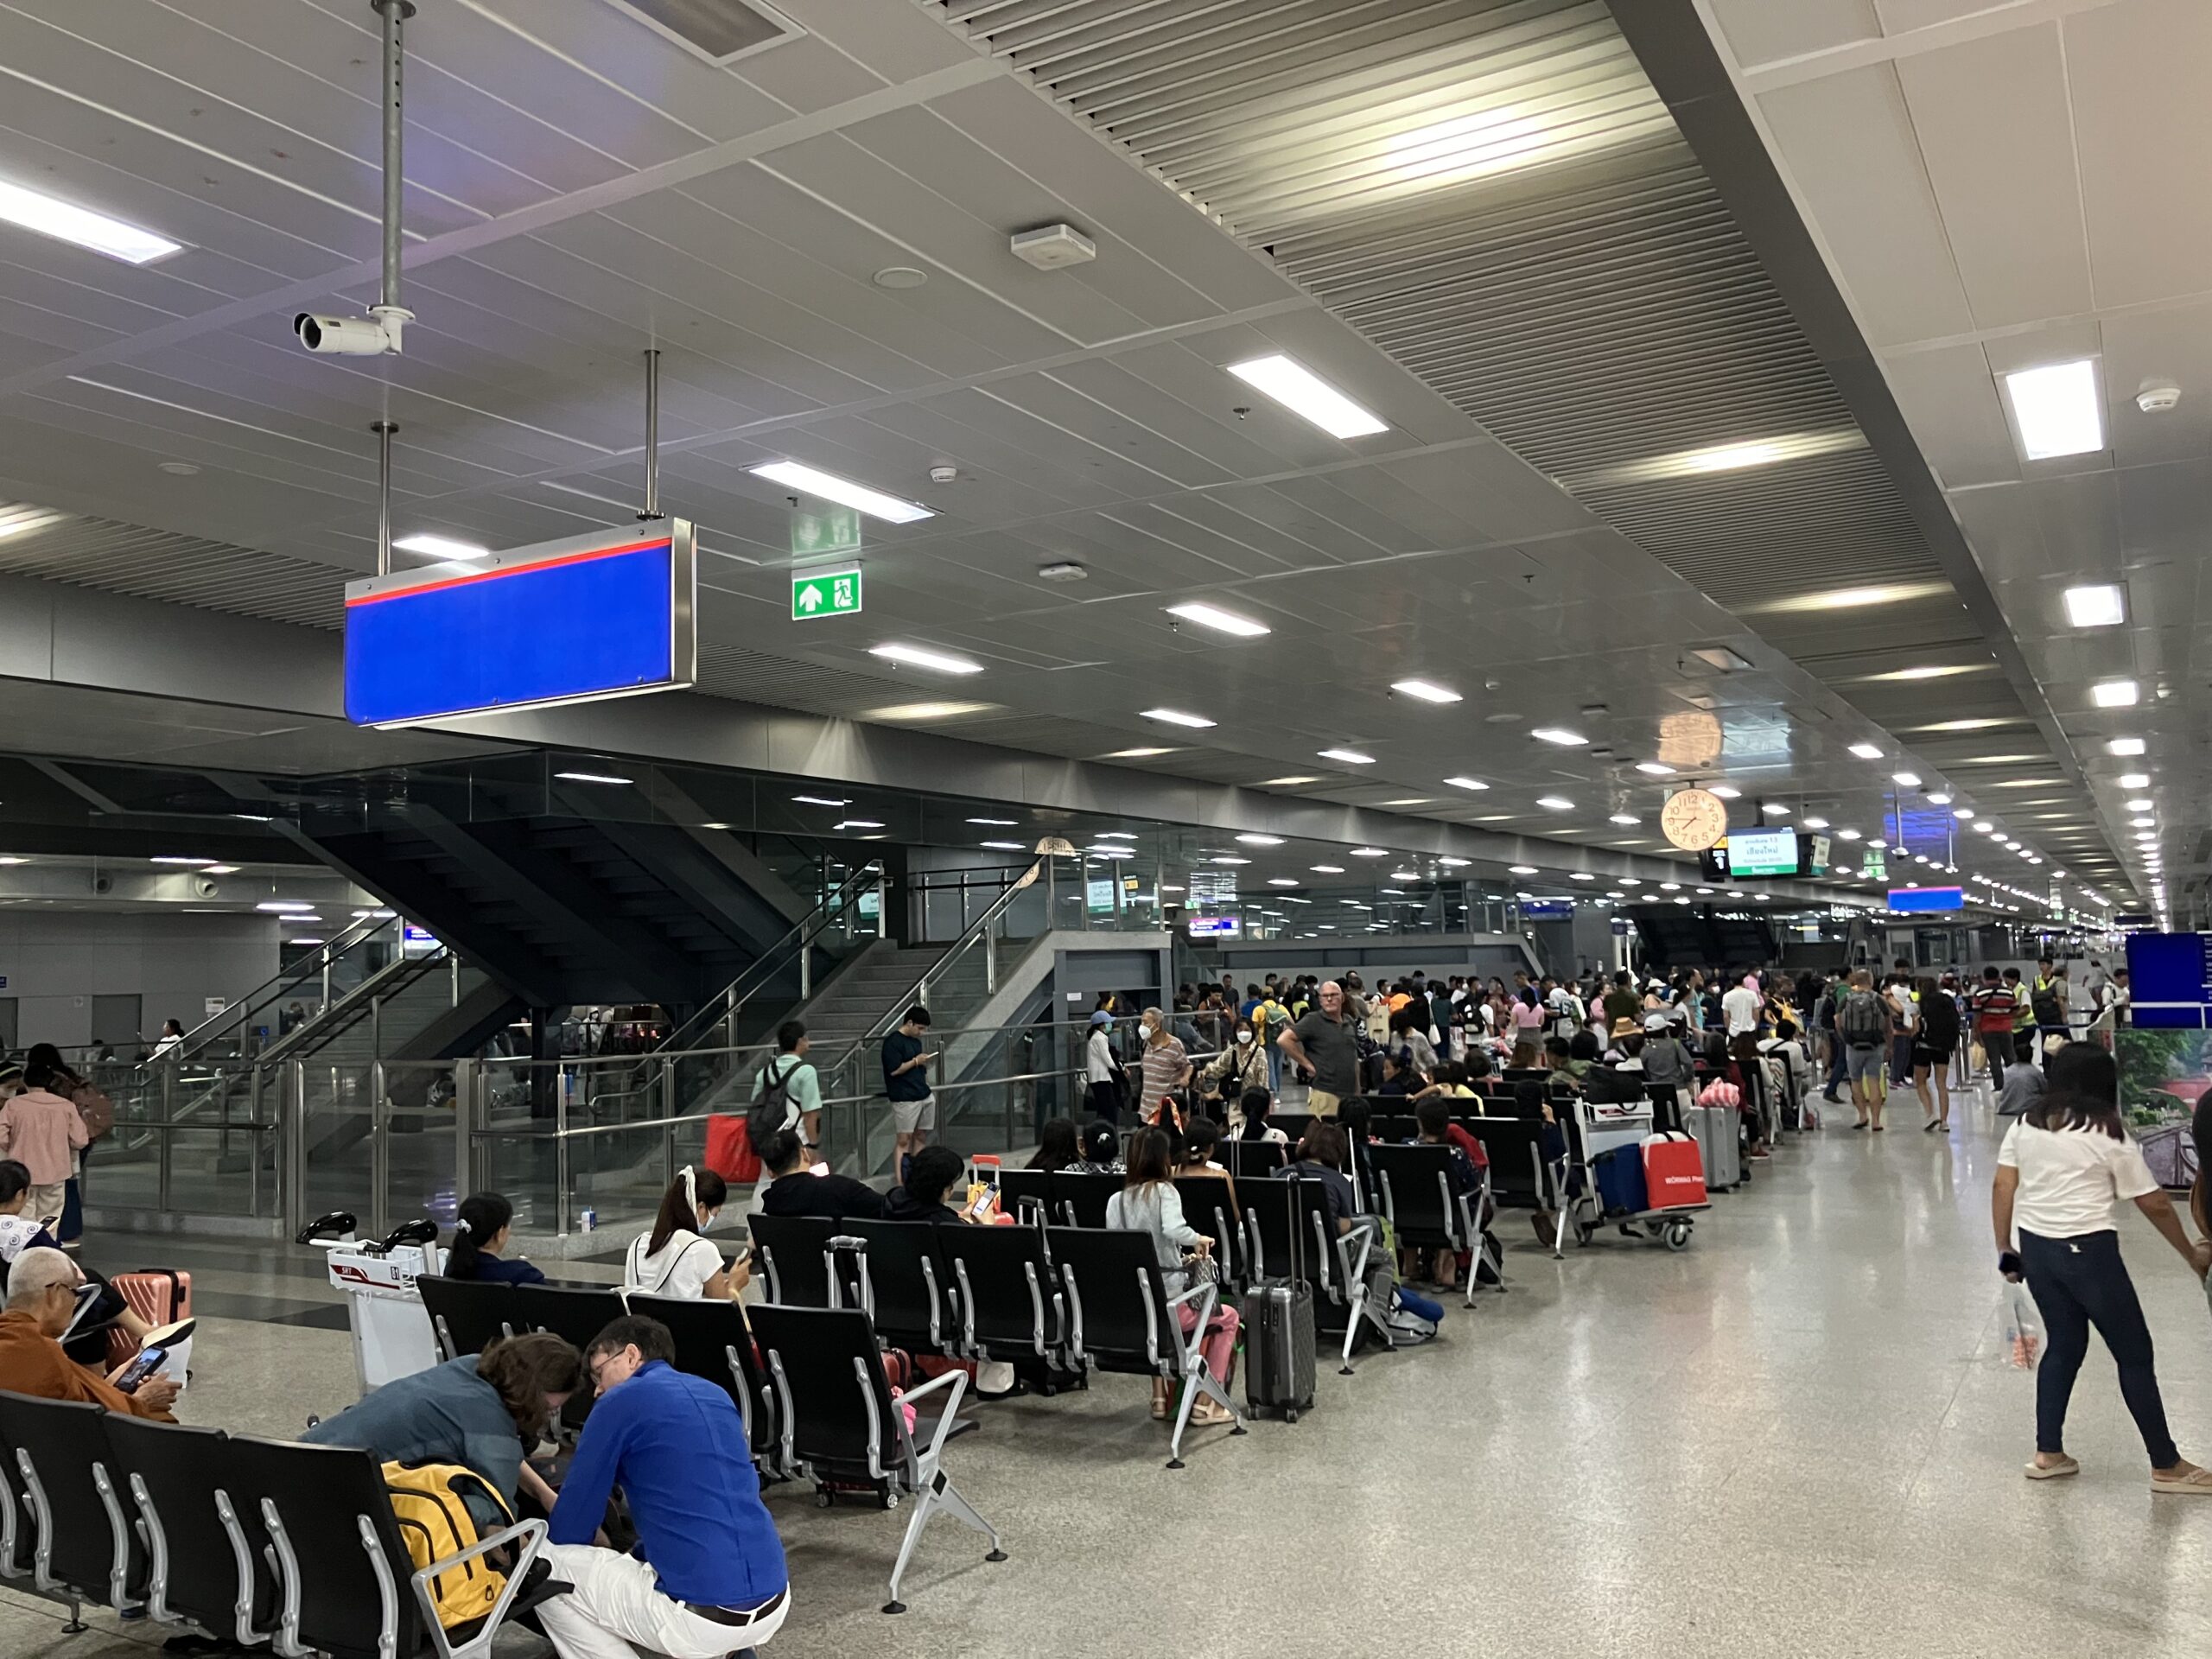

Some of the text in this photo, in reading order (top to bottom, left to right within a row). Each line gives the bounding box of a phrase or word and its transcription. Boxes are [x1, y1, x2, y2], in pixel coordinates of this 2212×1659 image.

[1678, 797, 1686, 806] 11
[1688, 795, 1697, 804] 12
[1669, 806, 1680, 815] 10
[1712, 813, 1719, 823] 3
[1673, 827, 1679, 836] 8
[1681, 834, 1688, 842] 7
[1691, 836, 1698, 844] 6
[1702, 832, 1708, 841] 5
[1715, 856, 1724, 869] 1
[341, 1267, 352, 1275] SRT
